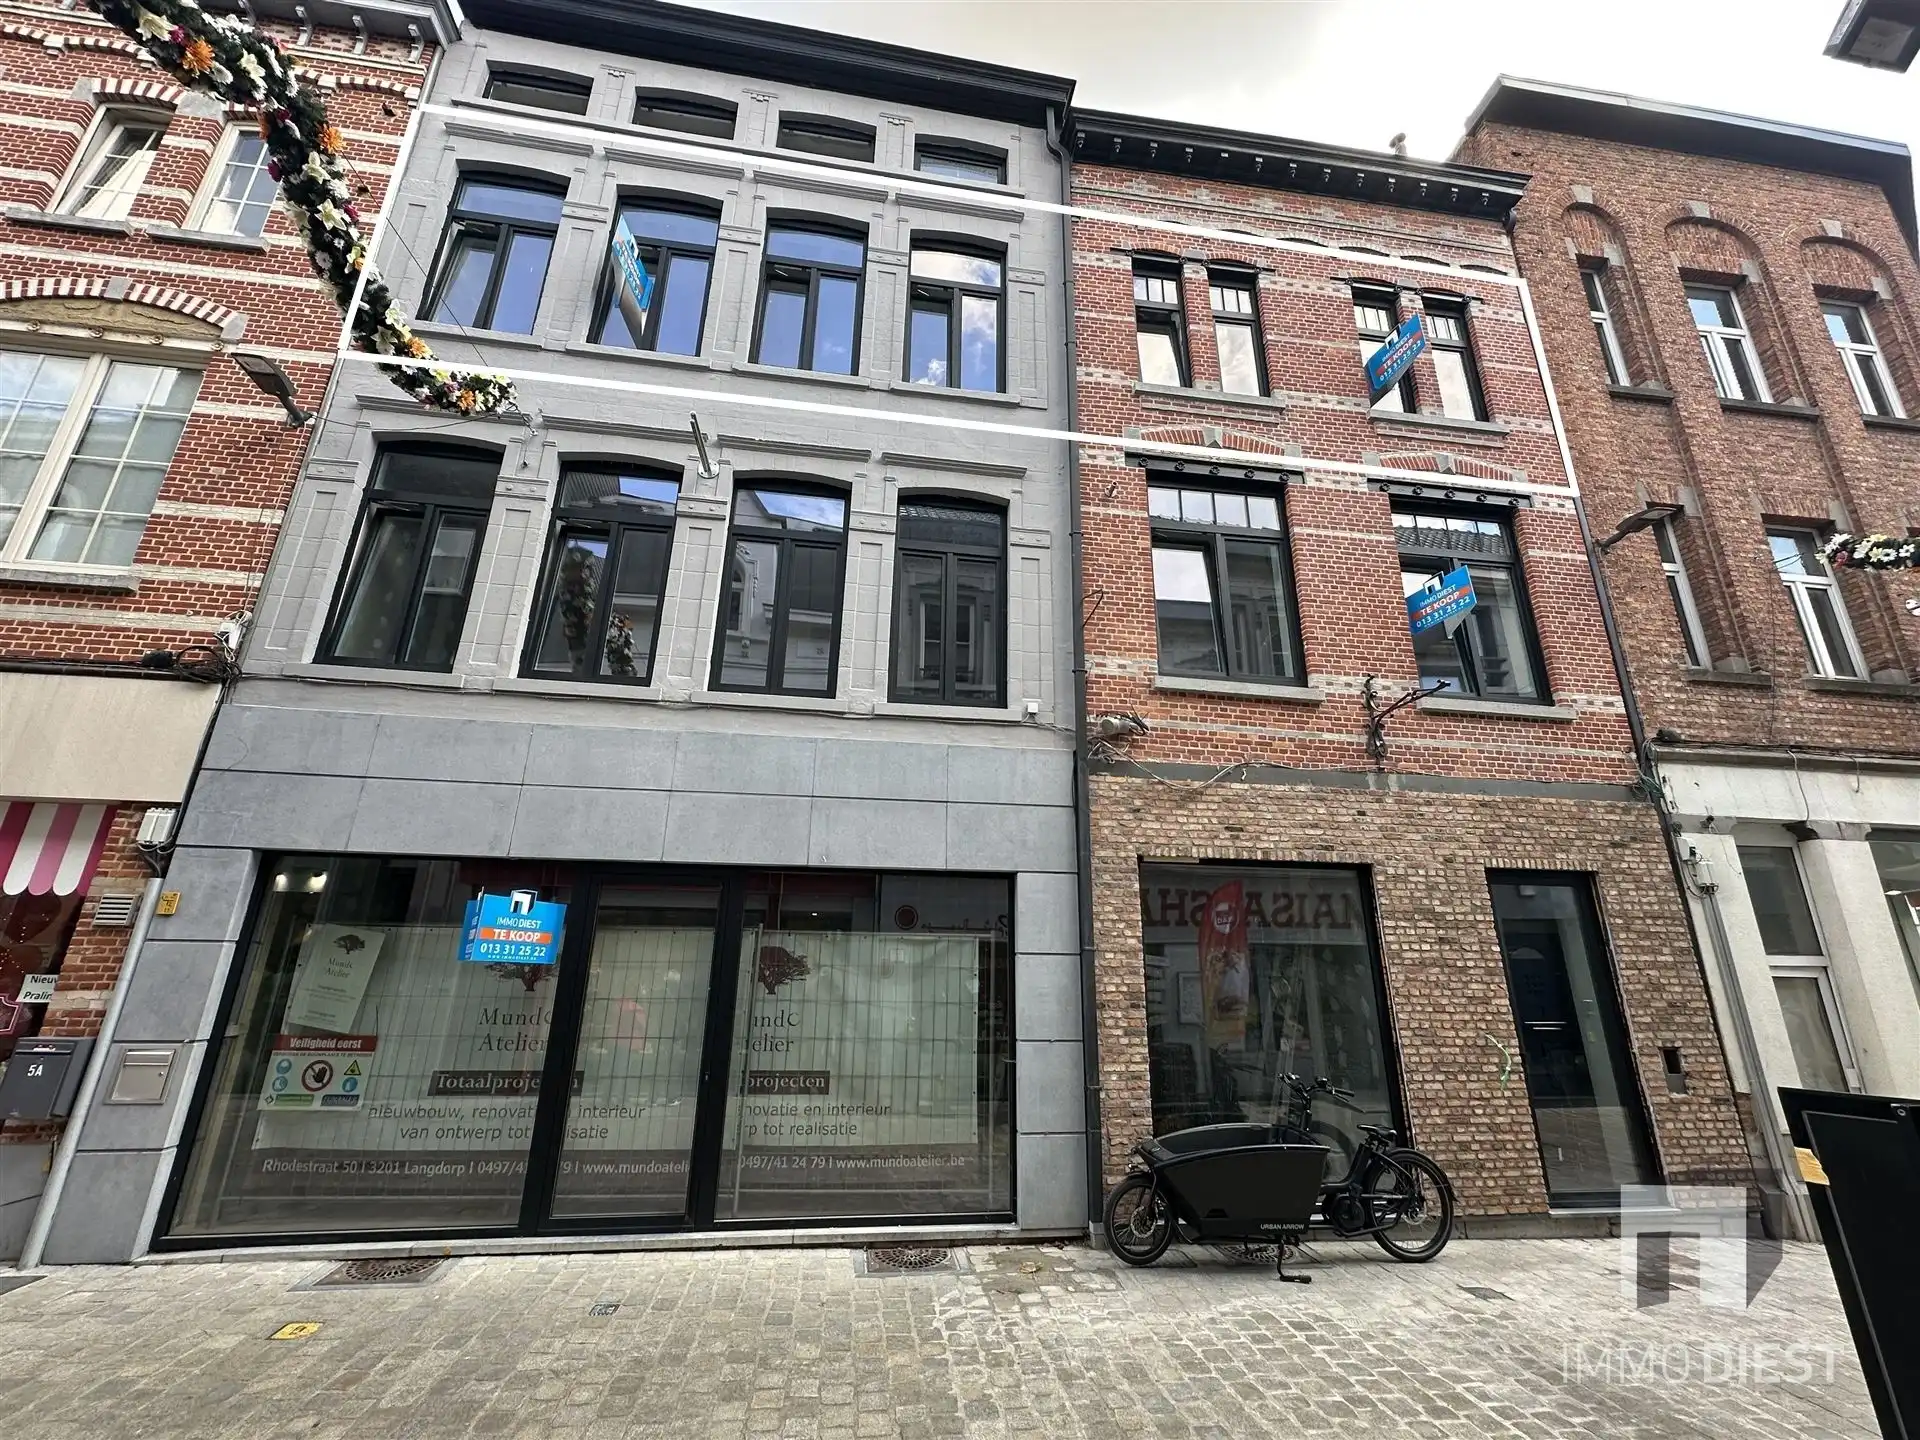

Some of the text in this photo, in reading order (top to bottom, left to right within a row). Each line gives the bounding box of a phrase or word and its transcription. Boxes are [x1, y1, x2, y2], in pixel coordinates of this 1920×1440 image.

[1383, 338, 1414, 369] TE KOOP
[1380, 367, 1392, 381] 013
[1420, 584, 1456, 608] IMMO DIEST
[1420, 591, 1460, 616] TE KOOP
[1416, 596, 1471, 628] 013 31 25 22
[496, 916, 542, 929] IMMO DIEST
[493, 929, 541, 943] TE KOOP
[480, 942, 547, 957] 013 31 25 22
[290, 1037, 362, 1049] Veiligheid eerst
[751, 1033, 794, 1052] elier
[27, 1064, 43, 1077] 5A
[368, 1103, 646, 1120] nieuwbouw, renovat interieur
[803, 1106, 821, 1117] en
[827, 1103, 891, 1117] interieur
[400, 1126, 429, 1140] van
[435, 1125, 501, 1142] ontwerp
[507, 1126, 531, 1140] tot
[763, 1123, 784, 1136] tot
[789, 1123, 858, 1136] realisatie
[262, 1158, 338, 1174] Rhodestraat
[341, 1160, 358, 1174] 50
[368, 1161, 401, 1175] 3201
[405, 1161, 465, 1177] Langdorp
[477, 1160, 526, 1177] 0497/4
[740, 1156, 788, 1171] 0497/41
[792, 1156, 807, 1169] 24
[810, 1156, 825, 1169] 79
[836, 1155, 966, 1169] www.mundoatelier.be
